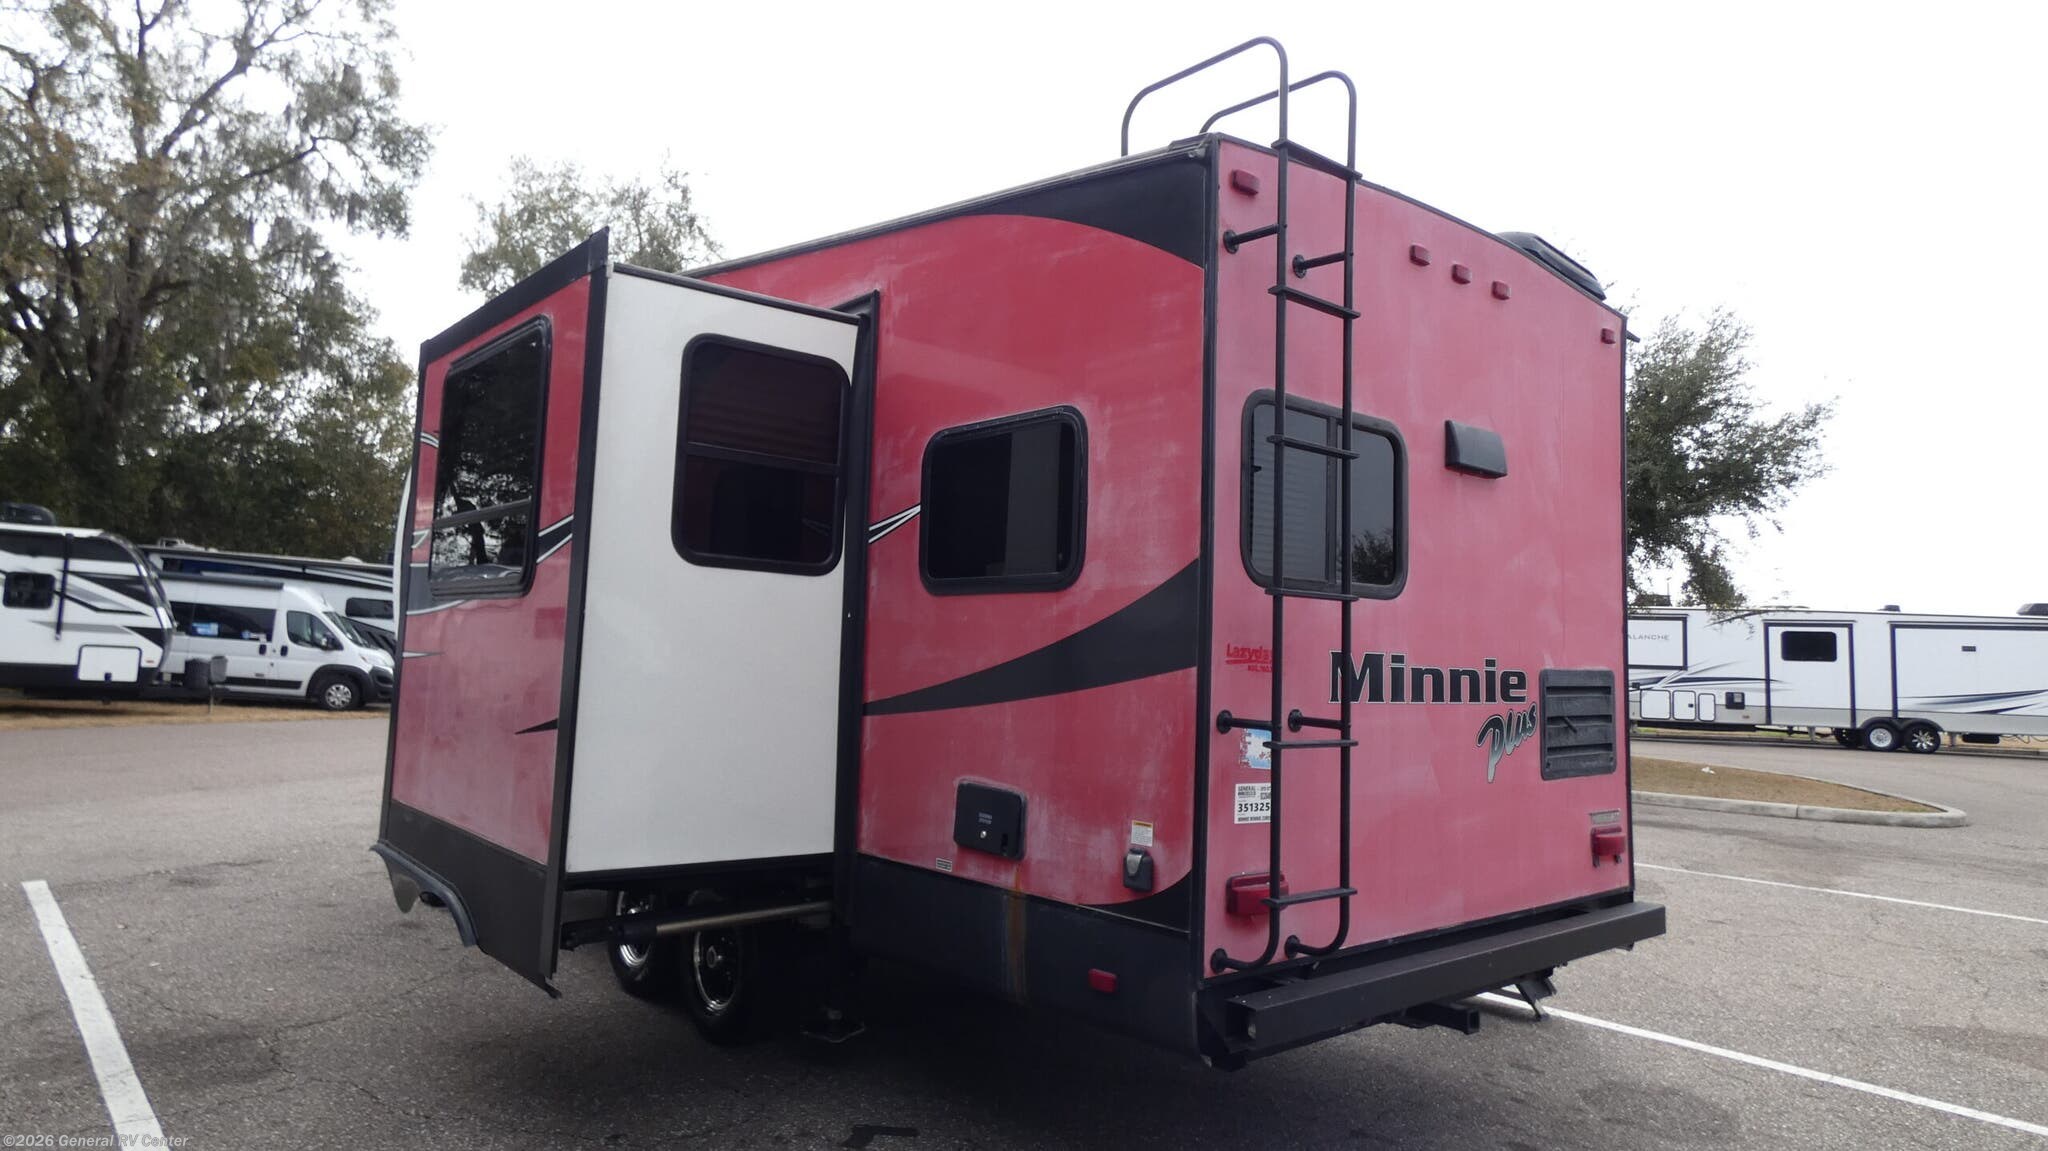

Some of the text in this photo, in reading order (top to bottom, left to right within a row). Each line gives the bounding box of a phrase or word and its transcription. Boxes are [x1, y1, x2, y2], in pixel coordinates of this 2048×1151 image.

[1226, 643, 1272, 660] Lazyda
[1329, 650, 1527, 704] Minnie
[1476, 702, 1537, 783] Plus
[1238, 802, 1270, 813] 351325
